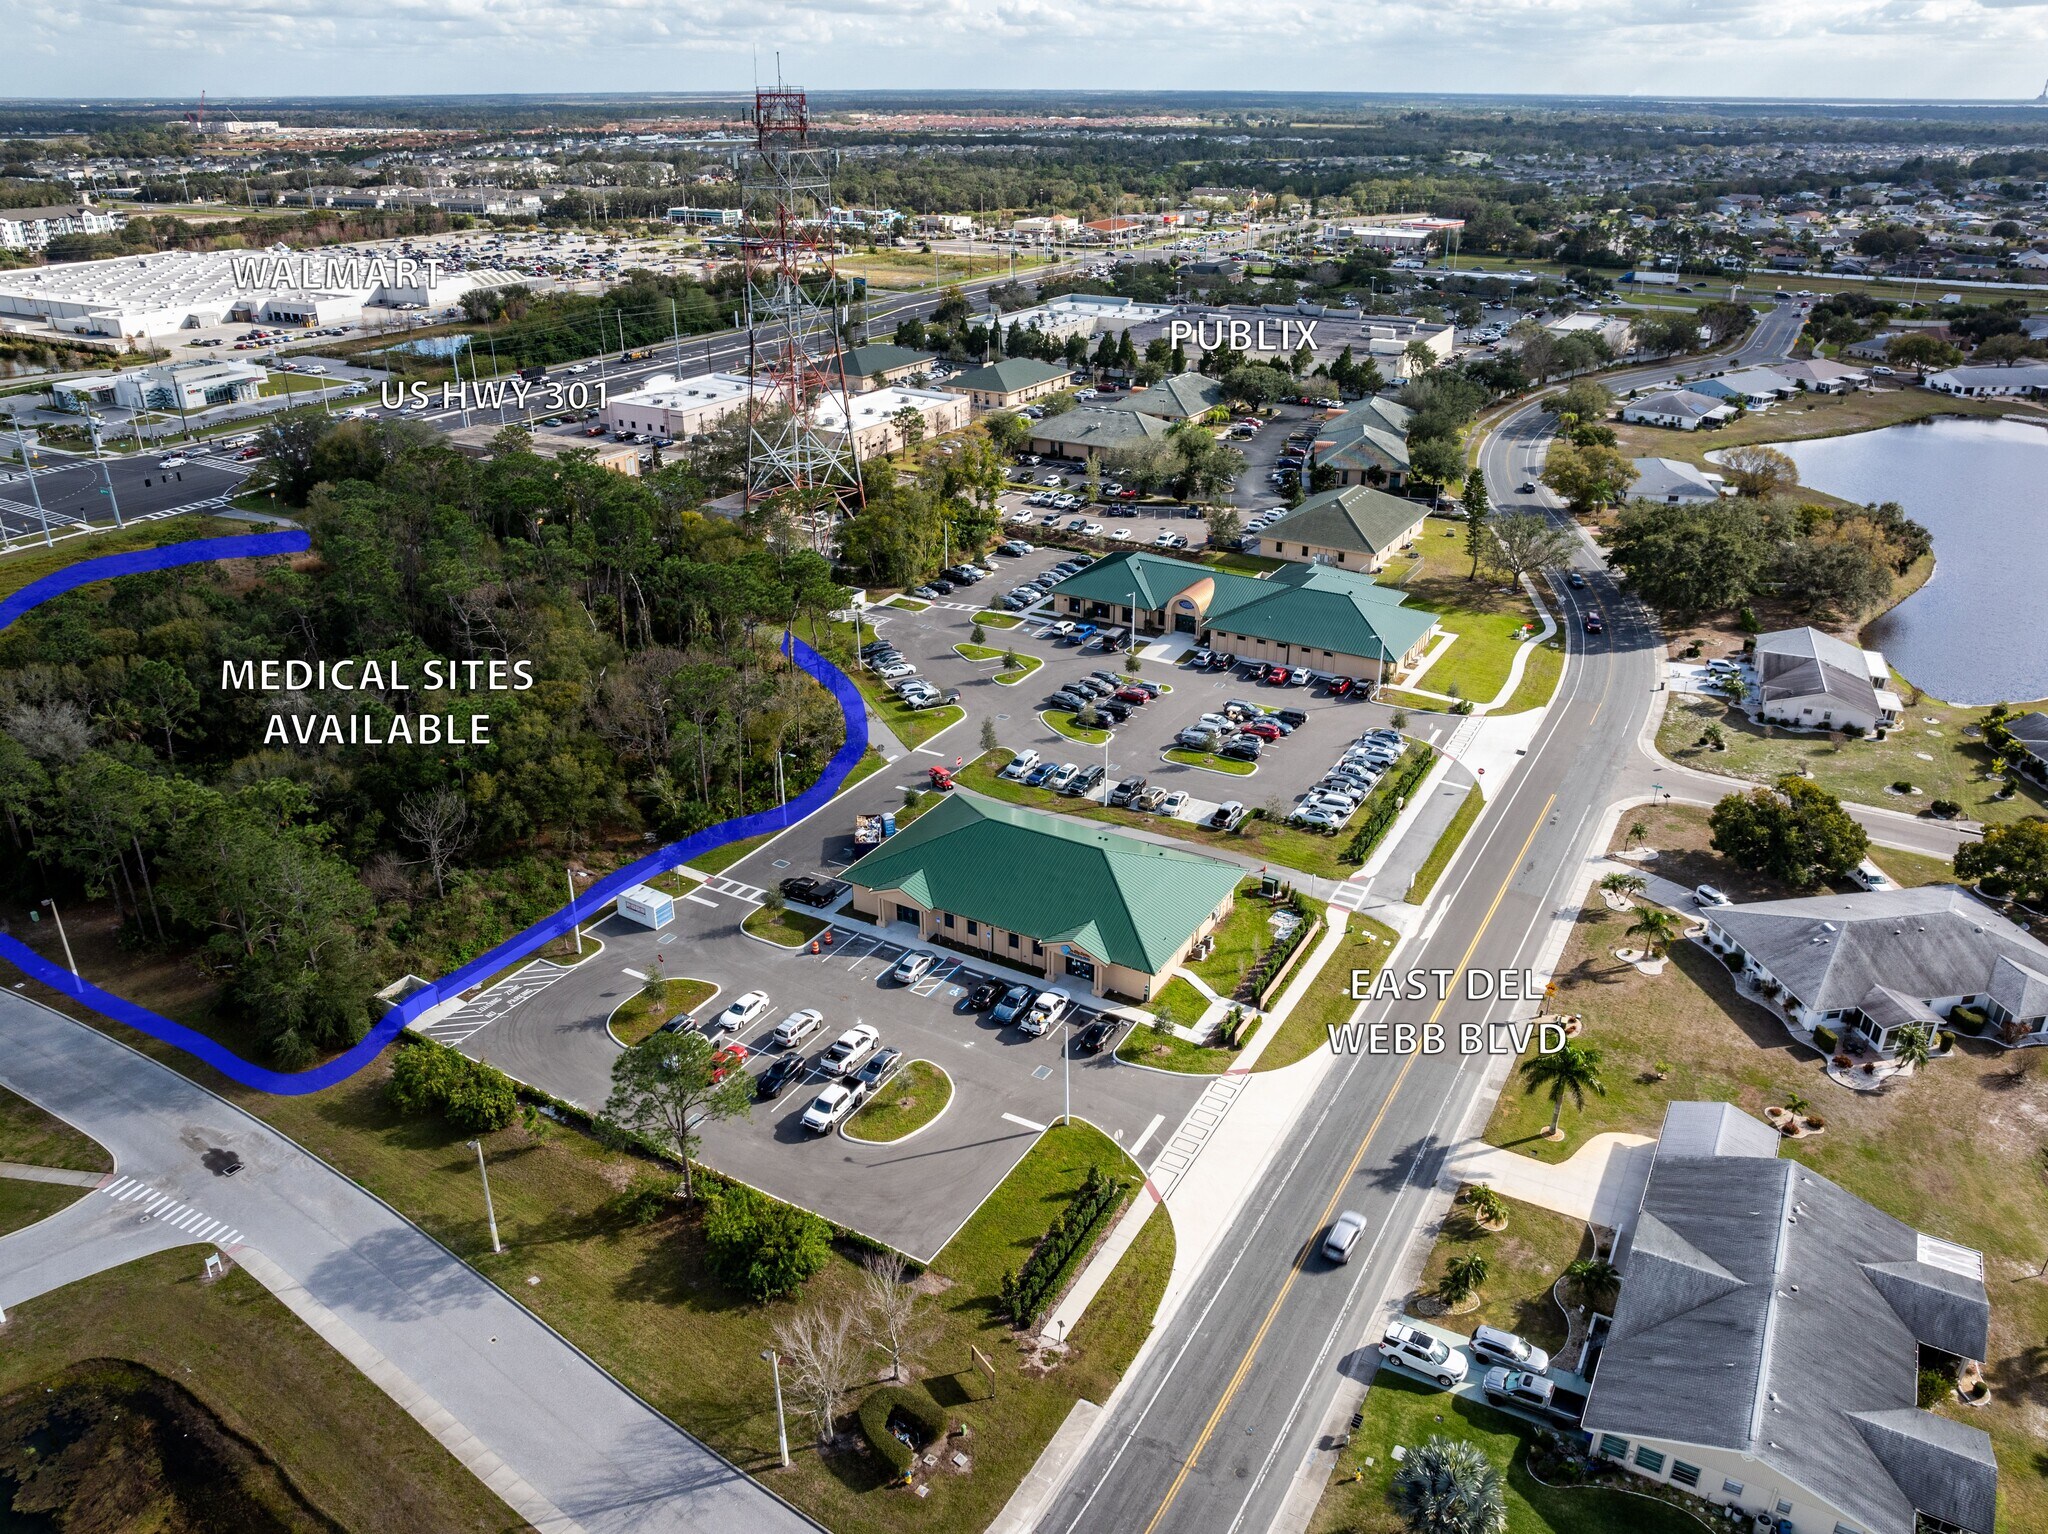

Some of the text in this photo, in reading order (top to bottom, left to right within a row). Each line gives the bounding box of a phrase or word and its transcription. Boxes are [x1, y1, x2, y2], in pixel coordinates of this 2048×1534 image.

[475, 984, 522, 1014] LOADING ZONE
[485, 988, 533, 1019] NO PARKING
